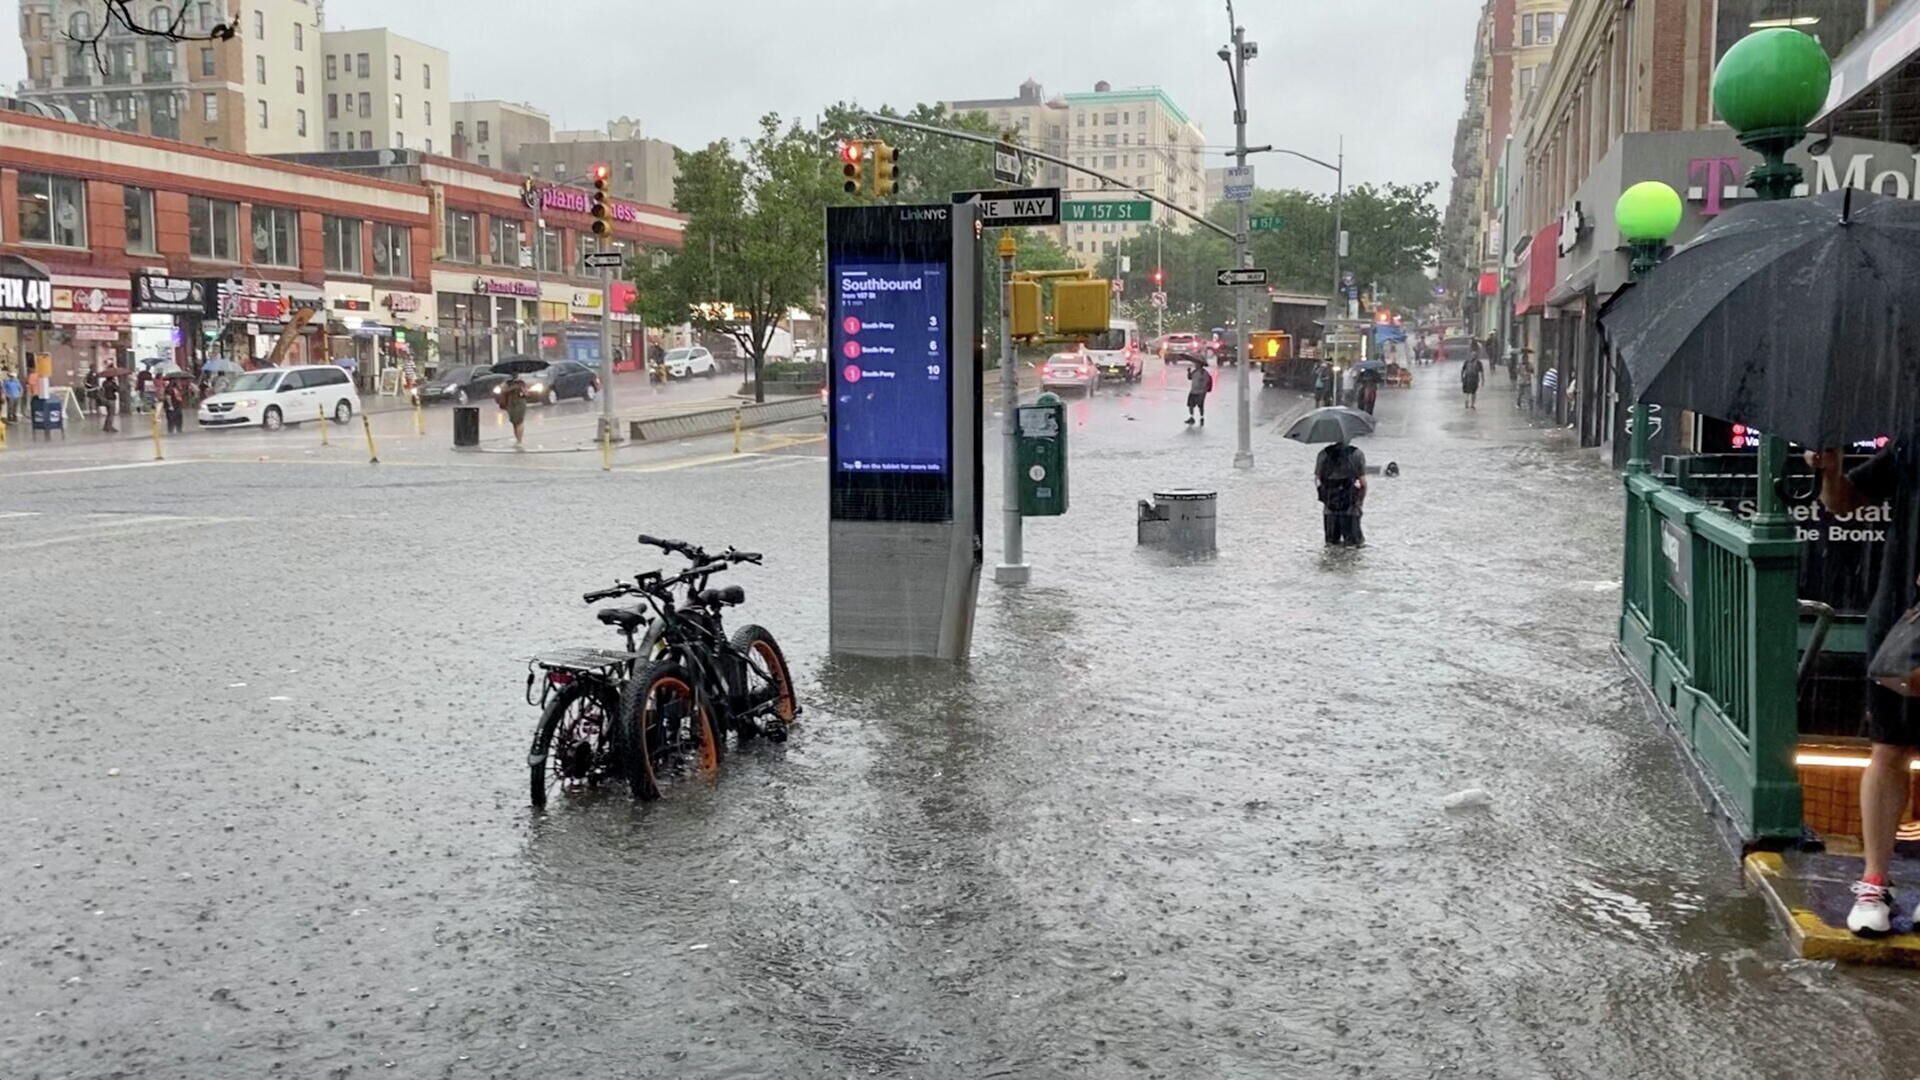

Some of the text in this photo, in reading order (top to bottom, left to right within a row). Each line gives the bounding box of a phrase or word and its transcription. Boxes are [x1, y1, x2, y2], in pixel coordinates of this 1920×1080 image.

[1811, 154, 1920, 200] Mo
[543, 187, 592, 213] planet
[900, 208, 947, 221] LinkNYC
[979, 200, 1046, 216] NE WAY
[1072, 204, 1132, 219] W 157 St
[842, 277, 922, 291] Southbound
[929, 316, 937, 326] 3
[929, 340, 937, 350] 6
[927, 365, 940, 375] 10
[1796, 526, 1885, 542] he Bronx
